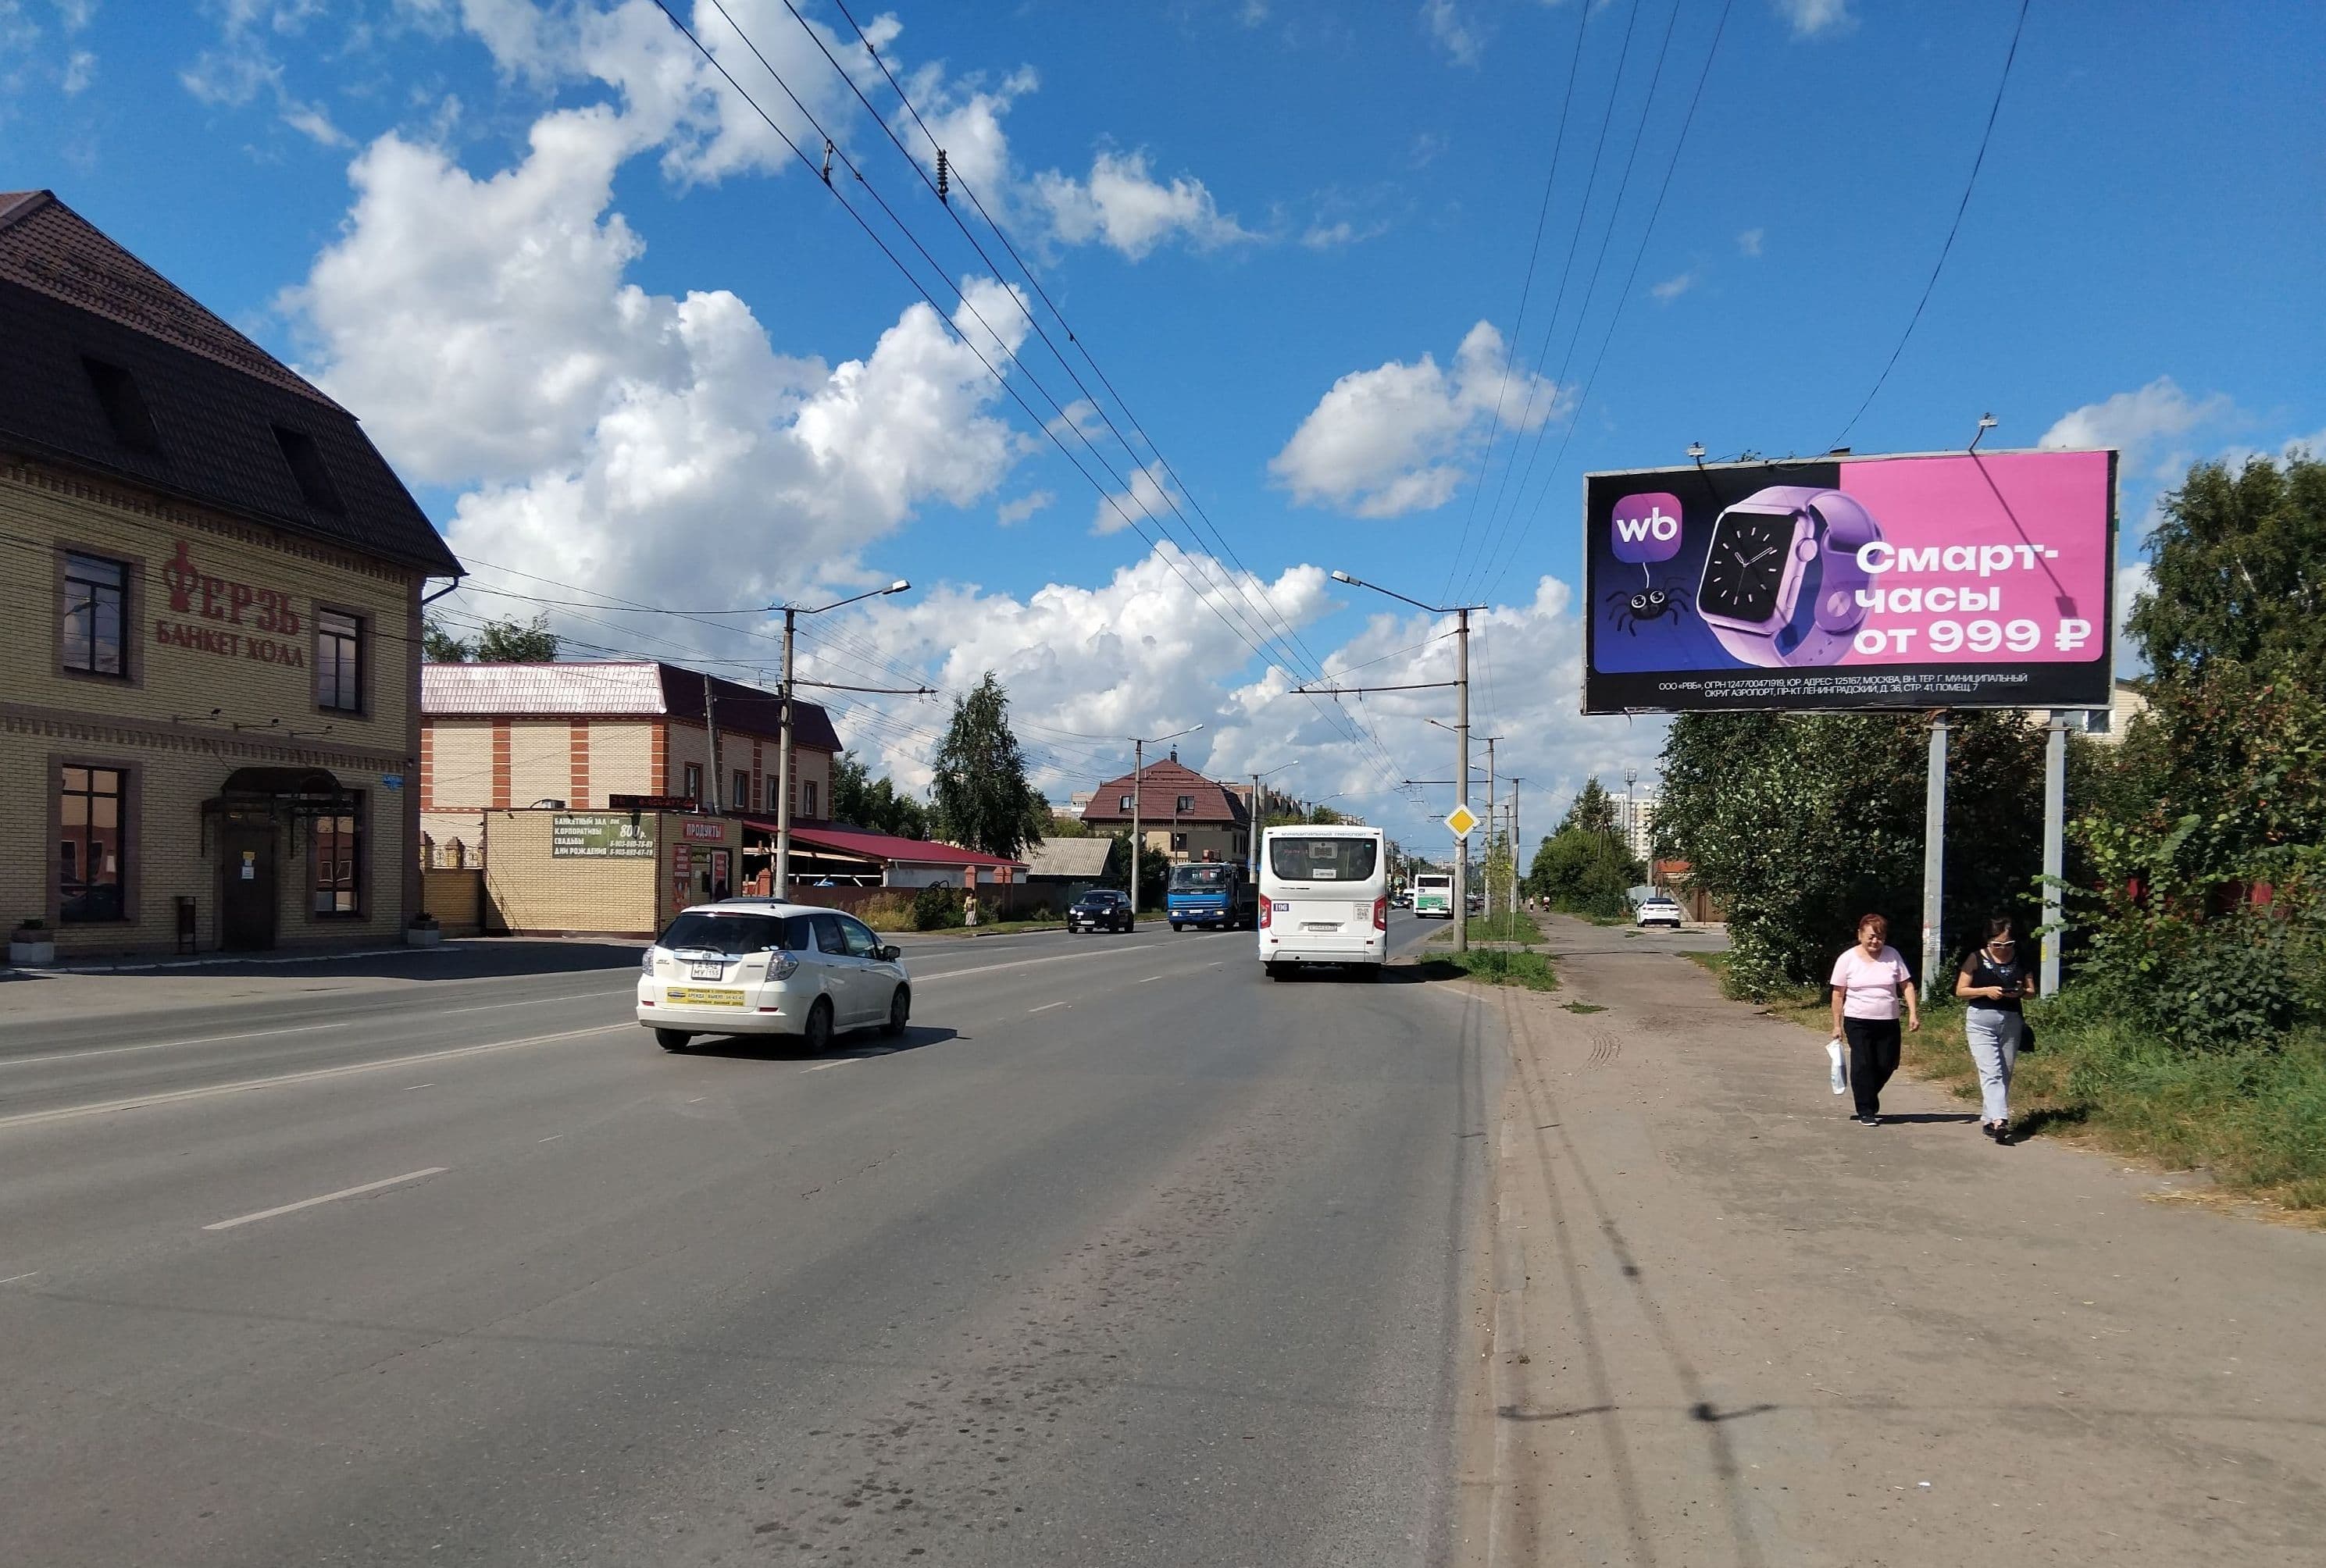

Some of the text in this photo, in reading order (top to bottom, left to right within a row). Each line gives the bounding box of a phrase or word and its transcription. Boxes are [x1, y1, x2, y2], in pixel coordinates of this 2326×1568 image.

[1616, 507, 1678, 543] wb
[1856, 540, 2059, 577] Смарт-
[1855, 586, 2000, 614] часы
[158, 619, 304, 668] БАНКЕТ ХОЛЛ
[1853, 628, 1918, 655] от
[1928, 619, 2041, 653] 999
[1704, 680, 1727, 689] ОГРН
[1946, 672, 2028, 683] МУНИЦИПАЛЬНЫЙ
[1704, 689, 1730, 697] ОКРУГ
[1777, 687, 1802, 696] ПР-КТ
[1972, 682, 1978, 691] 7
[619, 824, 640, 837] 800
[686, 822, 722, 838] ПРОДУКТЫ
